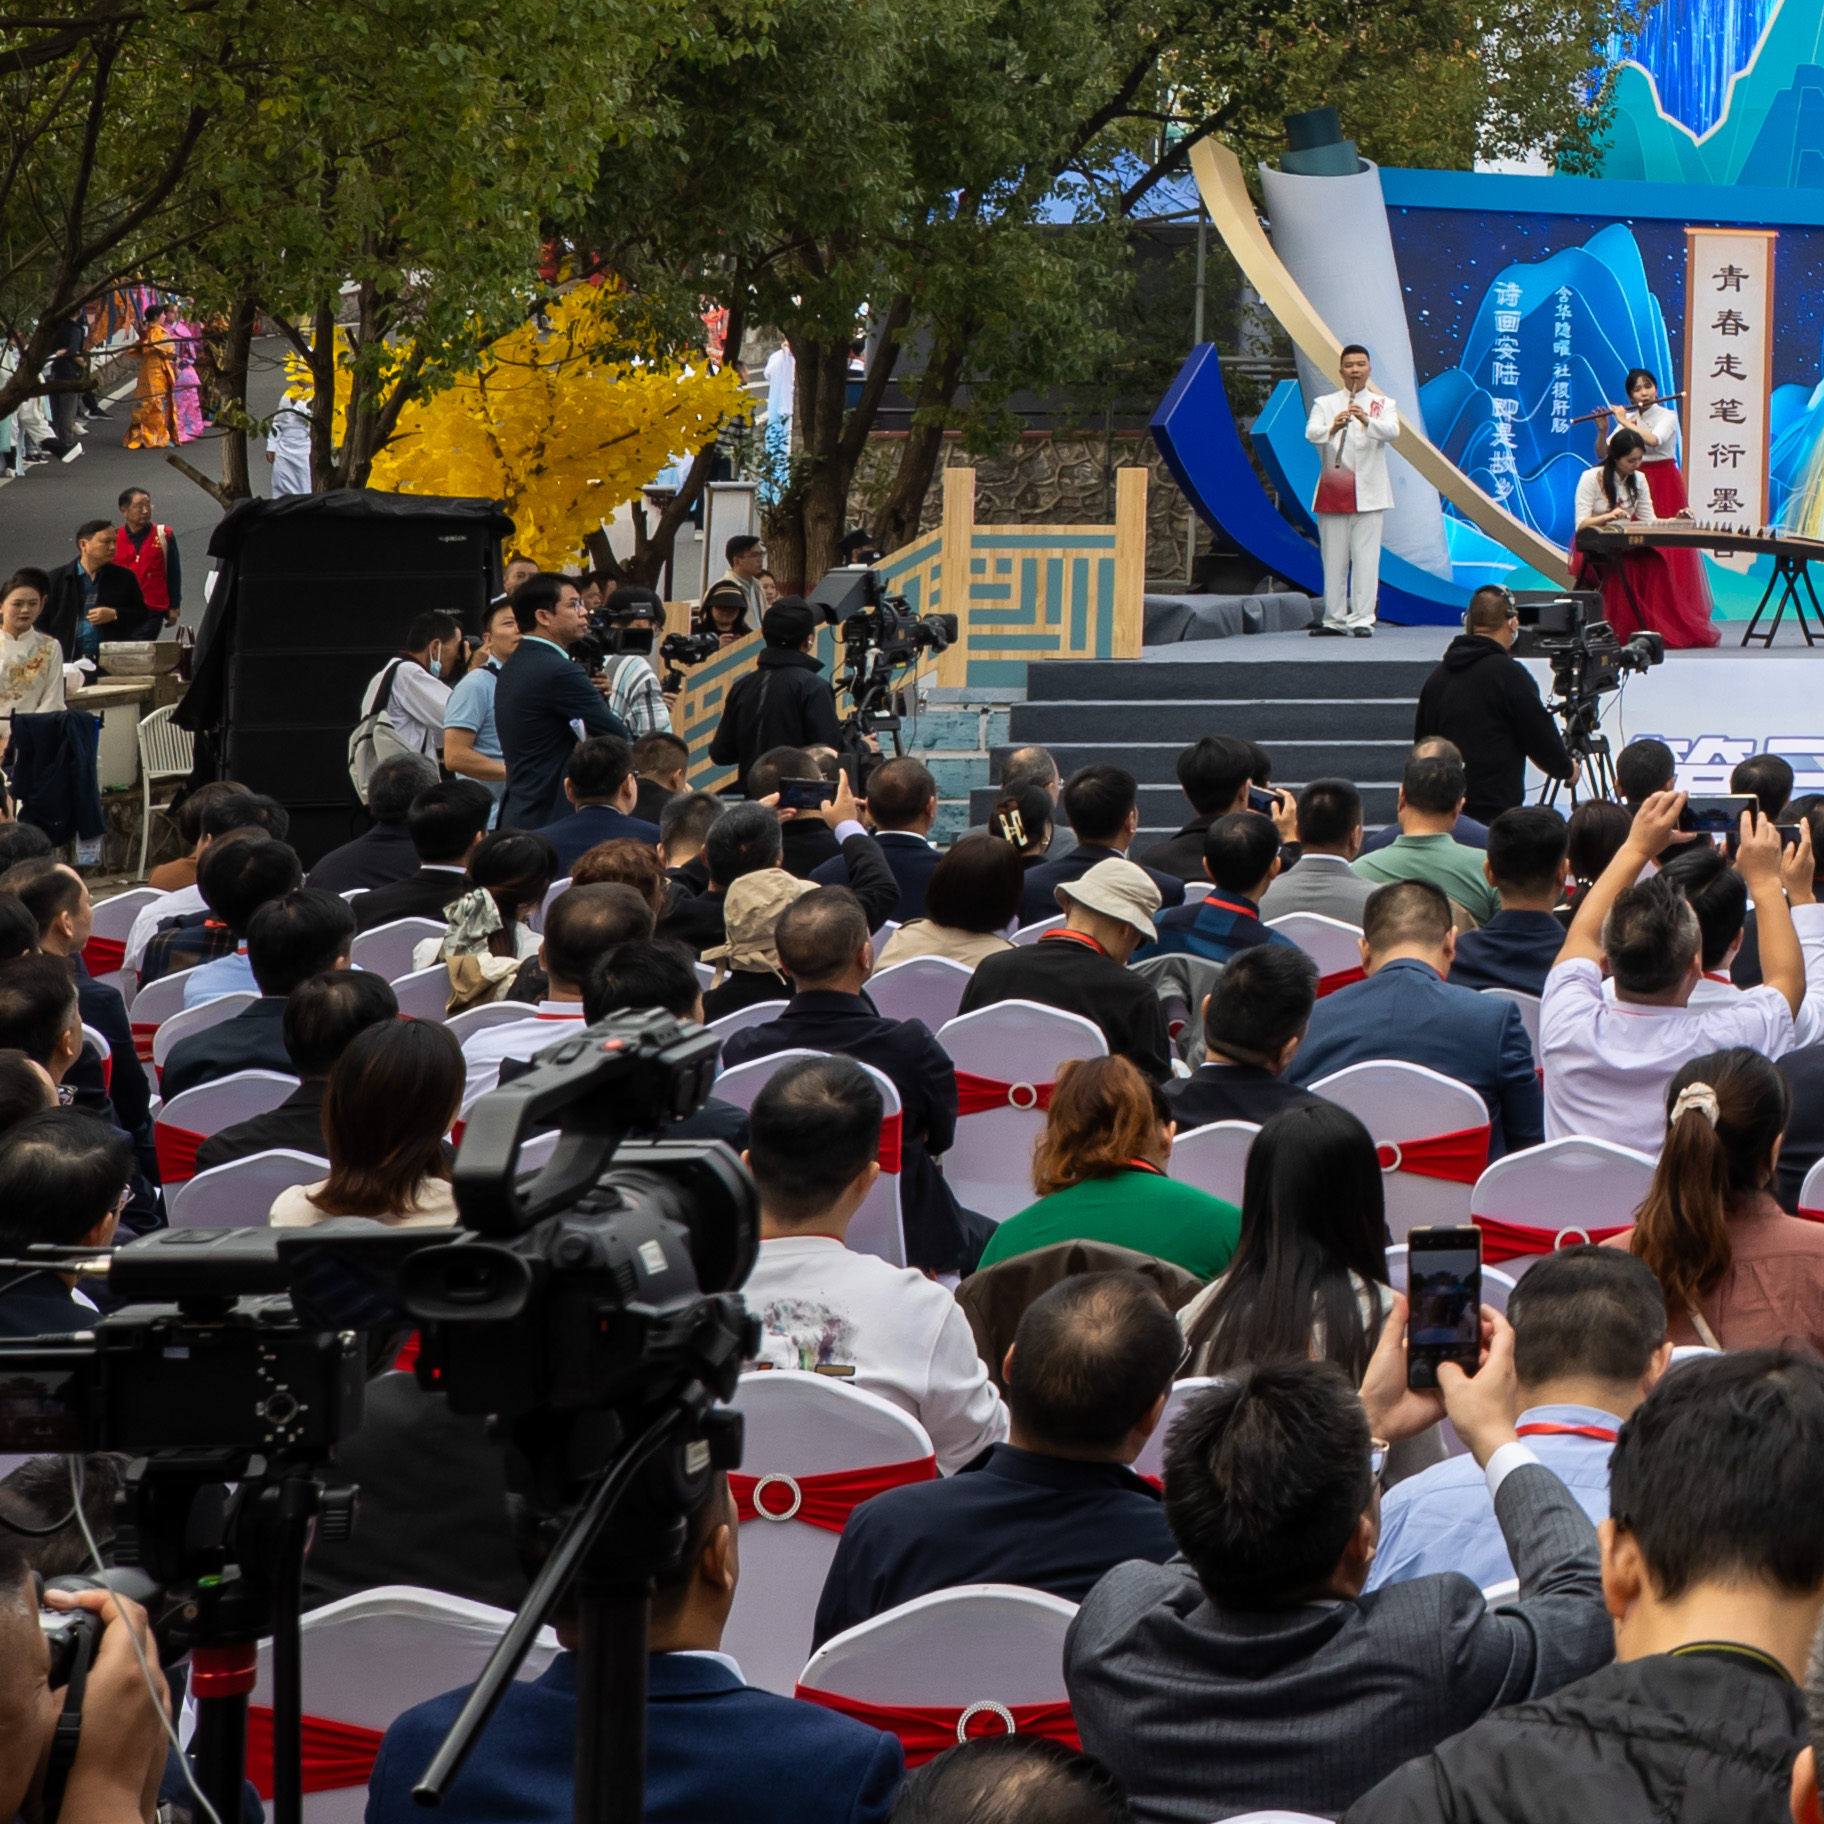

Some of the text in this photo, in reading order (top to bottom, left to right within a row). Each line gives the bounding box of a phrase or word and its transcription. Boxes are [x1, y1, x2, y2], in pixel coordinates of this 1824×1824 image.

[1489, 281, 1523, 502] 诗画安陆 即是故乡
[1707, 264, 1750, 559] 青春走笔衍墨
